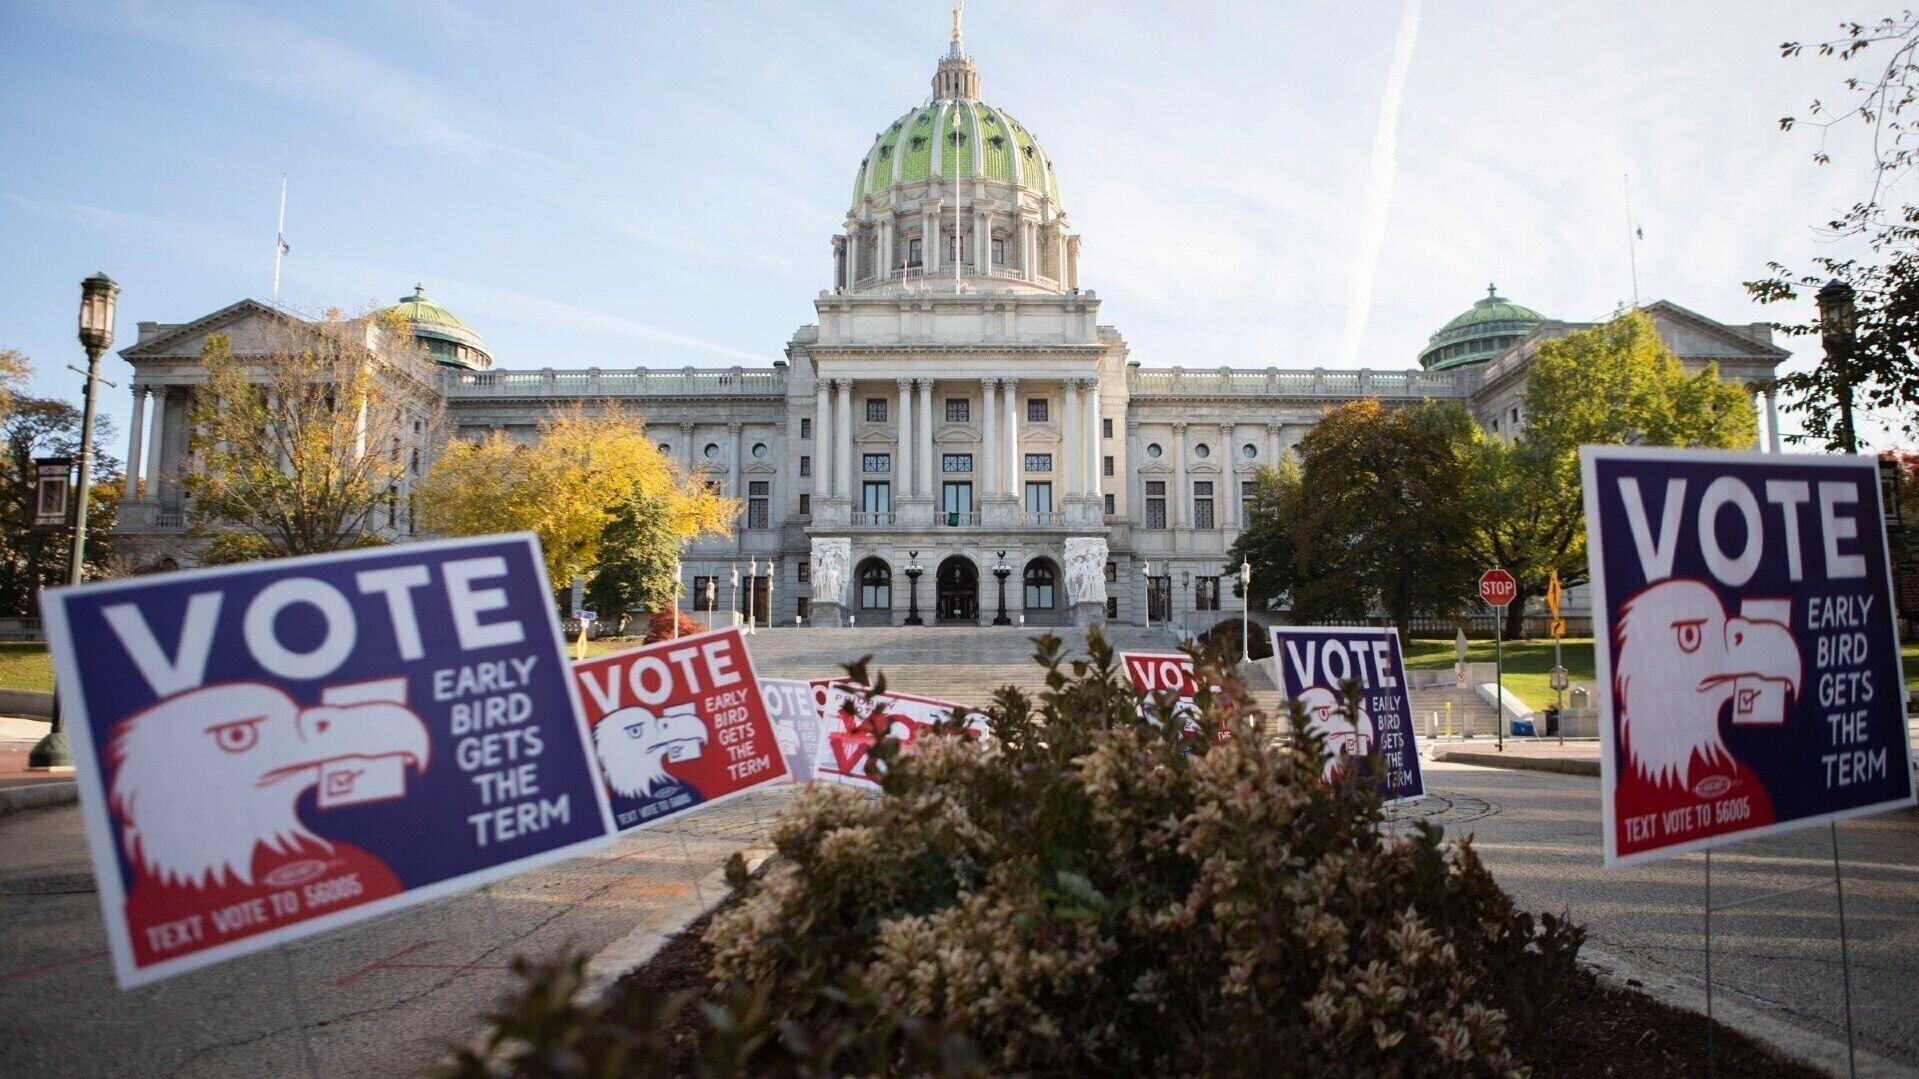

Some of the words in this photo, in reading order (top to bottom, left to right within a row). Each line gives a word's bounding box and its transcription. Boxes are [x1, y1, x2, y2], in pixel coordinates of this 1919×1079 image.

[1616, 475, 1867, 587] VOTE
[1482, 581, 1513, 595] STOP
[102, 556, 527, 698] VOTE
[1808, 595, 1874, 629] EARLY
[1286, 638, 1397, 691] VOTE
[1816, 632, 1868, 668] BIRD
[433, 655, 538, 701] EARLY
[579, 639, 742, 714] VOTE
[1132, 661, 1206, 692] VOT
[1818, 669, 1874, 709] GETS
[451, 692, 533, 735] BIRD
[705, 688, 748, 713] EARLY
[714, 706, 749, 729] BIRD
[763, 684, 812, 717] OTE
[718, 722, 755, 746] GETS
[1827, 709, 1869, 746] THE
[456, 726, 544, 771] GETS
[726, 740, 756, 762] THE
[727, 754, 771, 780] TERM
[1386, 751, 1404, 767] THE
[1821, 746, 1887, 789] TERM
[472, 763, 540, 805] THE
[467, 793, 571, 847] TERM
[1624, 813, 1657, 843] TEXT
[1662, 806, 1694, 835] VOTE
[1695, 803, 1711, 827] TO
[1716, 796, 1750, 823] 56005
[145, 915, 204, 952] TEXT
[210, 898, 268, 933] VOTE
[269, 890, 299, 917] TO
